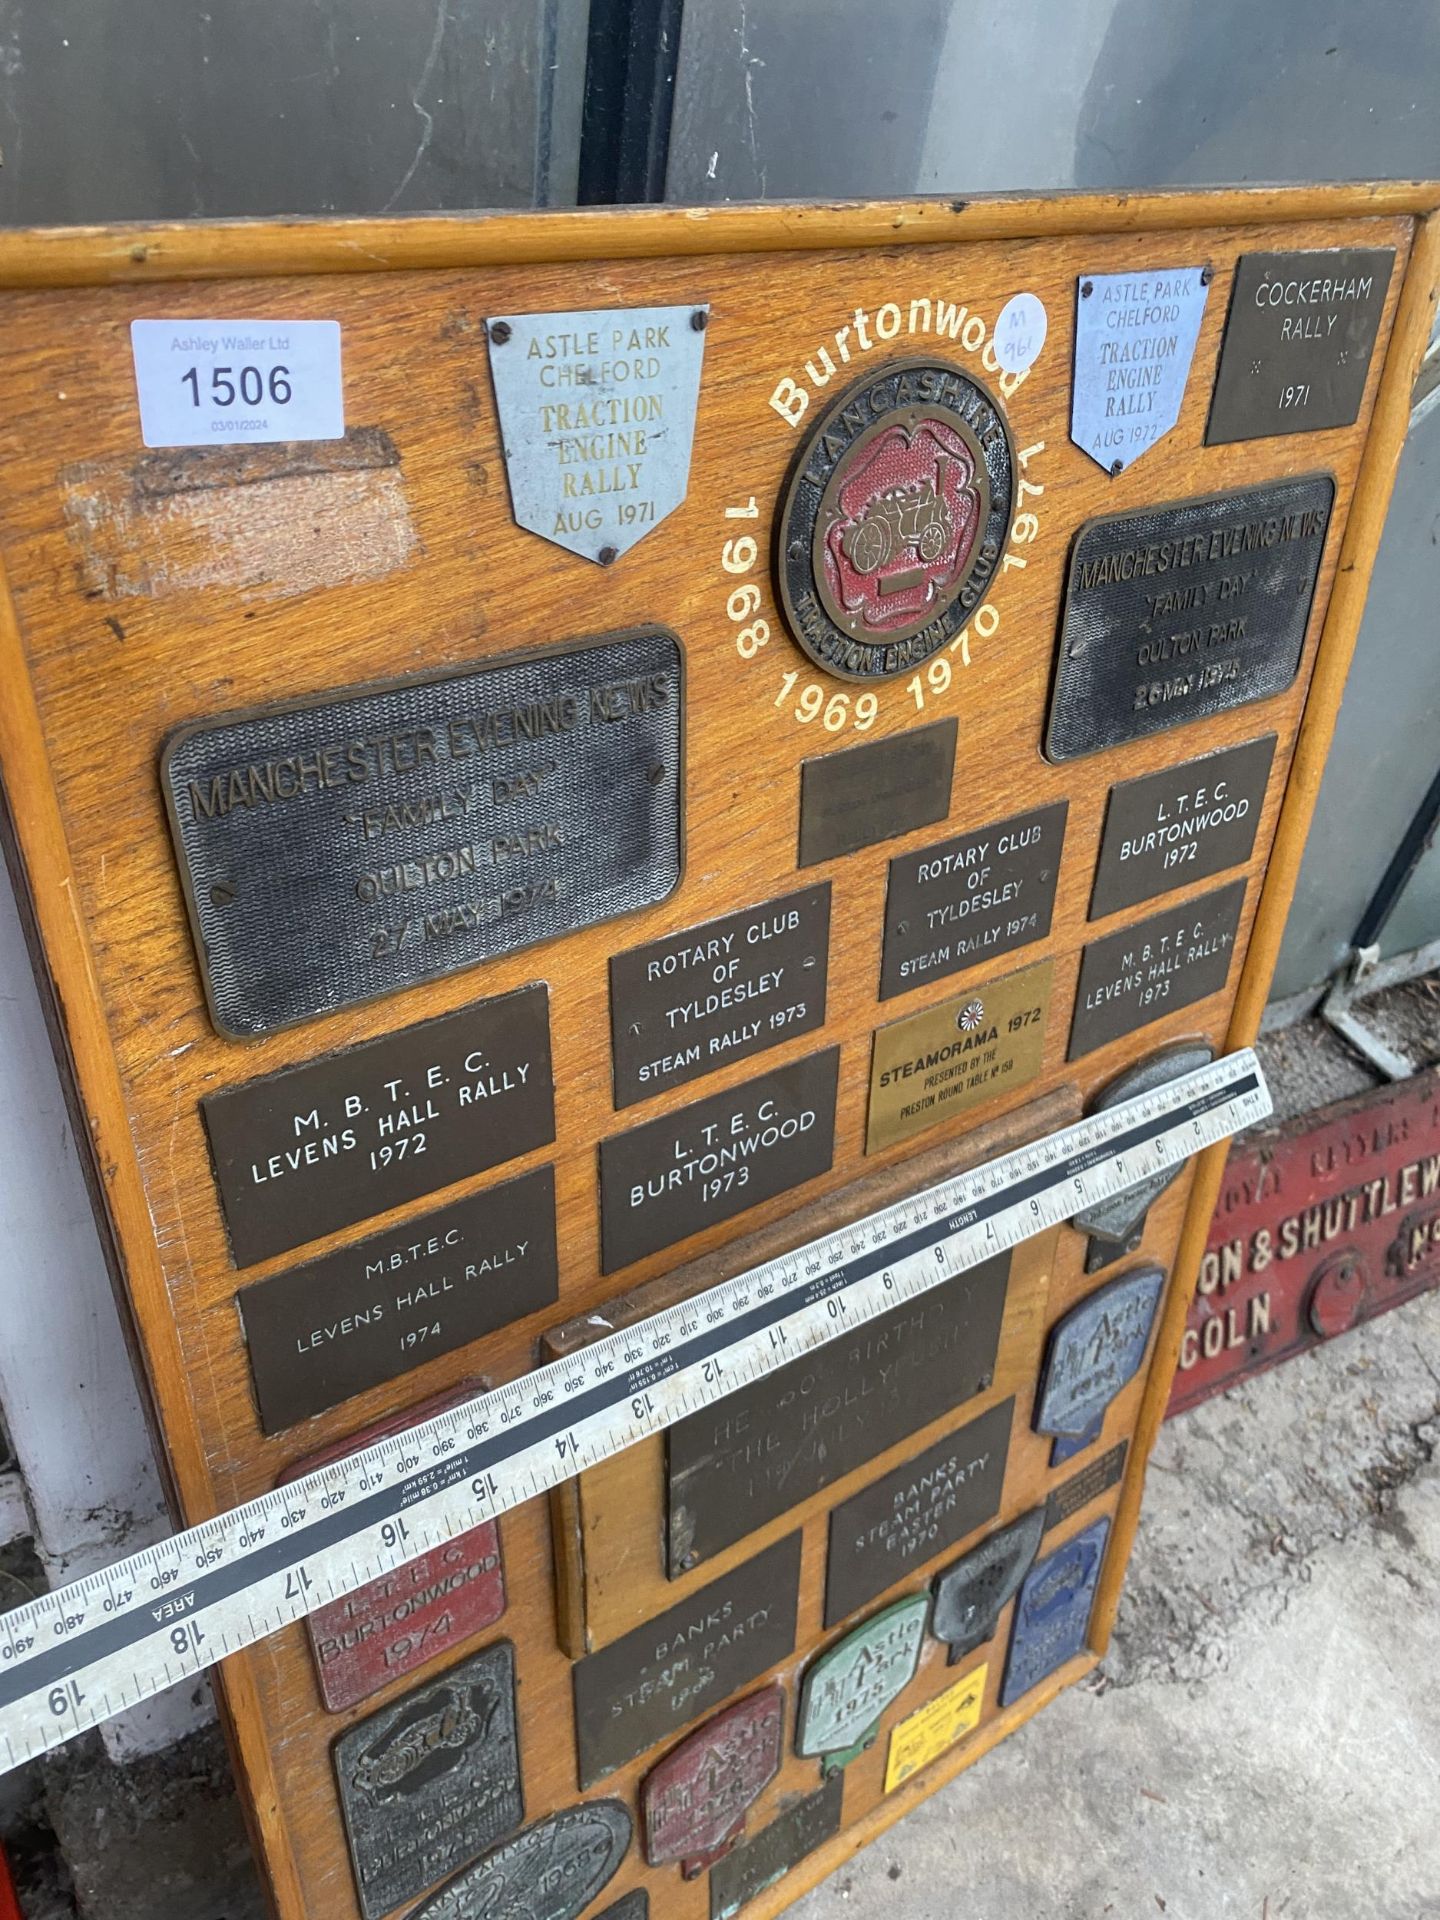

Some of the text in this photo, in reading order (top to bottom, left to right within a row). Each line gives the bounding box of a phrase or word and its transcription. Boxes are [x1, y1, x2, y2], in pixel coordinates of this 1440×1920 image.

[1103, 279, 1191, 302] ASTLE PARK
[1255, 277, 1373, 308] COCKERHAM
[1106, 305, 1180, 326] CHELFORD
[1281, 314, 1338, 340] RALLY
[171, 337, 290, 353] Ashley Waller Ltd
[528, 326, 670, 360] ASTLE PARK
[1100, 337, 1177, 365] TRACTION
[182, 366, 291, 407] 1506
[540, 359, 661, 388] CHELFORD
[1107, 365, 1162, 390] ENGINE
[539, 395, 664, 434] TRACTION
[1105, 392, 1157, 417] RALLY
[1279, 386, 1310, 408] 1971
[211, 420, 268, 432] 03/01/2024
[802, 371, 1002, 487] LANCASHIRE
[1093, 425, 1158, 450] AUG 1972
[558, 429, 648, 465] ENGINE
[562, 464, 641, 499] RALLY
[553, 503, 654, 536] AUG 1971
[1003, 440, 1046, 574] 1971
[1079, 511, 1324, 591] MANCHESTER EVENING NEWS
[721, 496, 770, 659] 1968
[794, 544, 996, 671] TRACTION ENGINE CLUB
[1138, 618, 1248, 665] OULTON PARK
[773, 604, 1001, 732] 1969 1970
[192, 675, 669, 821] MANCHESTER EVENING NEWS
[1119, 799, 1249, 861] BURTONWOOD
[355, 823, 562, 904] OULTON PARK
[918, 825, 1041, 884] ROTARY CLUB
[1163, 841, 1198, 870] 1972
[967, 866, 991, 890] OF
[927, 880, 1024, 930] TYLDESLEY
[370, 920, 409, 959] 27
[425, 898, 485, 941] MAY
[647, 910, 800, 981] ROTARY CLUB
[900, 912, 1038, 977] STEAM RALLY 1974
[713, 959, 740, 984] OF
[1086, 932, 1233, 1010] LEVENS HALL RALLY
[665, 968, 784, 1029] TYLDESLEY
[1138, 980, 1170, 1007] 1973
[638, 1003, 807, 1082] STEAM RALLY 1973
[880, 1008, 1041, 1088] STEAMORAMA 1972
[923, 1048, 997, 1090] PRESENTED BY THE
[900, 1095, 935, 1120] PRESTON
[938, 1081, 964, 1105] ROUND
[966, 1071, 988, 1090] TABLE
[252, 1063, 530, 1184] LEVENS HALL RALLY
[1193, 1122, 1201, 1135] 2
[370, 1132, 427, 1171] 1972
[630, 1111, 816, 1207] BURTONWOOD
[1155, 1140, 1163, 1153] 3
[1116, 1159, 1123, 1173] 4
[702, 1166, 749, 1202] 1973
[1074, 1178, 1082, 1194] 5
[949, 1210, 978, 1230] LENGTH
[1030, 1200, 1039, 1216] 6
[985, 1222, 994, 1239] 7
[934, 1247, 944, 1263] 8
[1198, 1239, 1242, 1295] ON
[1252, 1229, 1273, 1272] &
[297, 1241, 529, 1354] LEVENS HALL RALLY
[882, 1272, 893, 1290] 9
[827, 1296, 846, 1319] 10
[400, 1322, 441, 1351] 1974
[768, 1326, 788, 1349] 11
[1179, 1292, 1270, 1370] COLN
[701, 1359, 724, 1383] 12
[631, 1394, 655, 1420] 13
[554, 1431, 580, 1460] 14
[472, 1472, 499, 1502] 15
[894, 1456, 957, 1509] BANKS
[855, 1500, 920, 1552] STEAM
[931, 1453, 989, 1503] PARTY
[380, 1518, 410, 1549] 16
[886, 1494, 956, 1551] EASTER
[902, 1524, 938, 1557] 1970
[284, 1566, 314, 1600] 17
[151, 1592, 196, 1624] AREA
[319, 1555, 498, 1664] BURTONWOOD
[170, 1620, 206, 1655] 18
[656, 1601, 732, 1660] BANKS
[612, 1659, 688, 1718] STEAM
[704, 1604, 772, 1659] PARTY
[848, 1619, 920, 1678] Astle
[48, 1678, 86, 1717] 19
